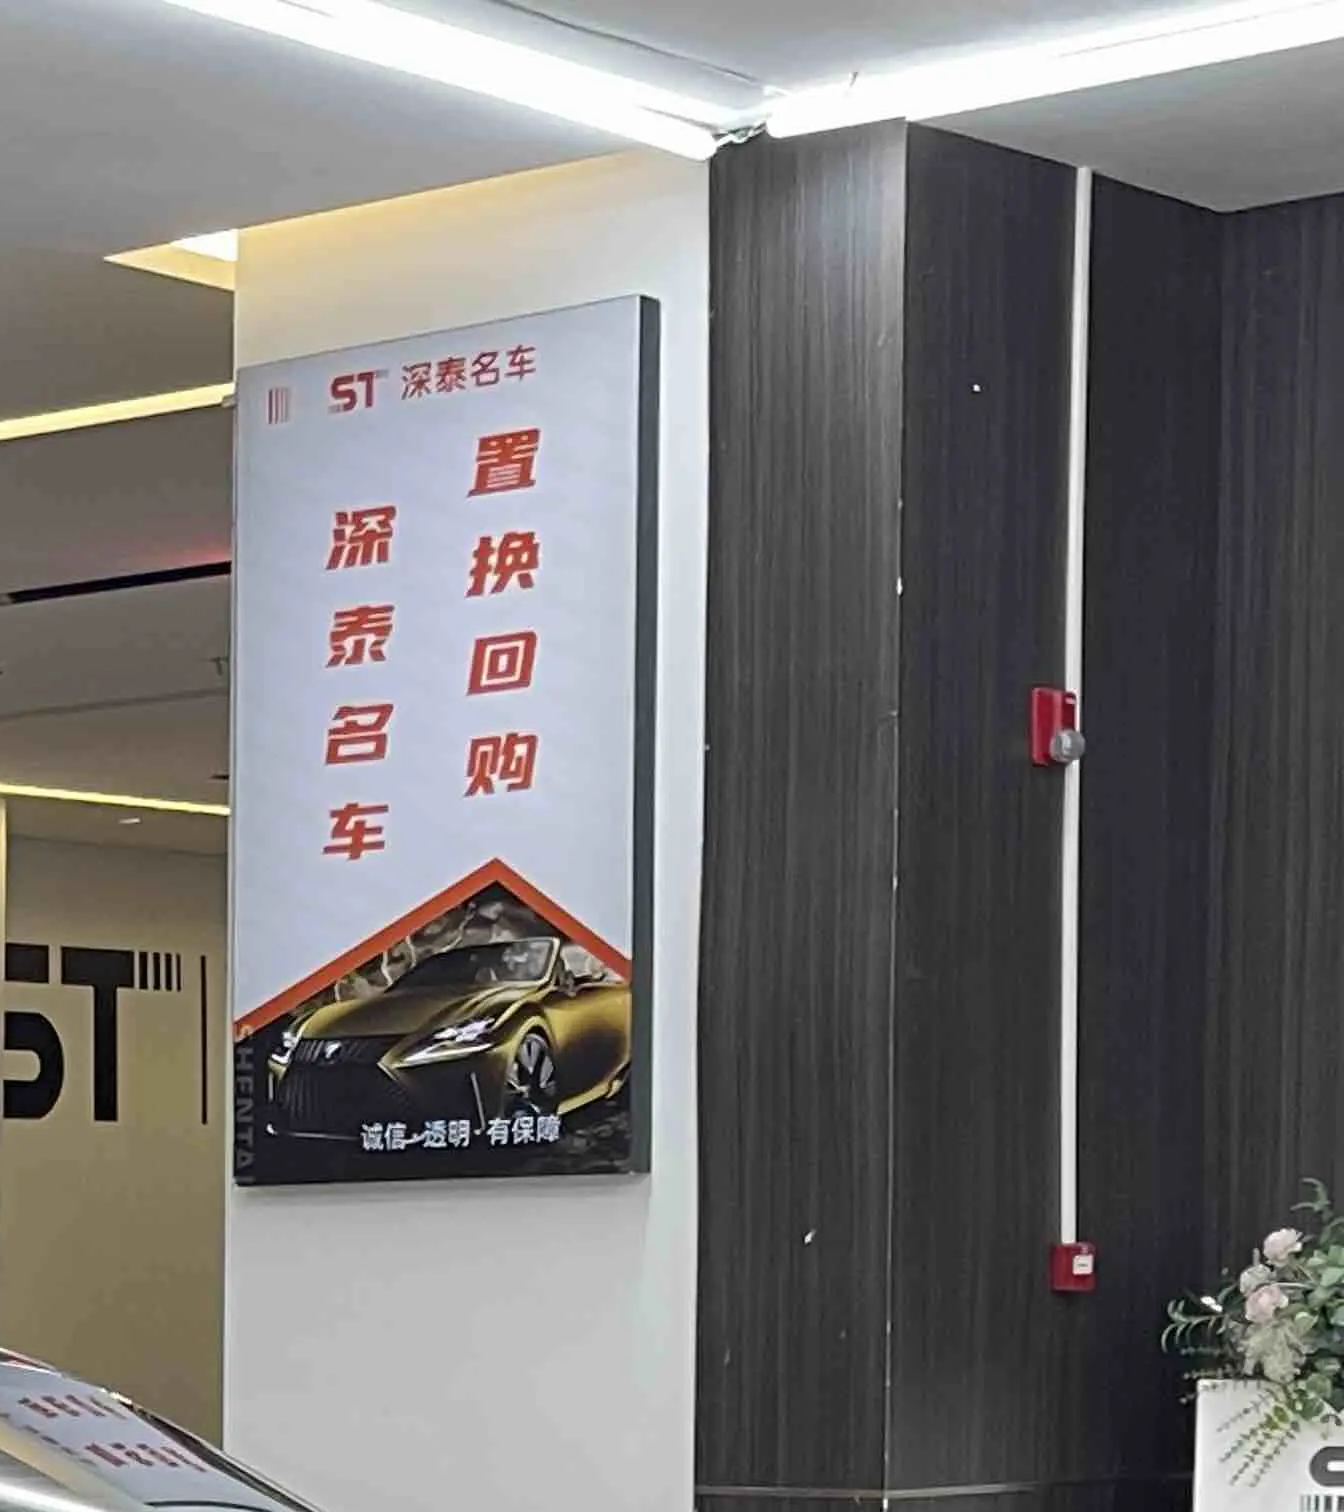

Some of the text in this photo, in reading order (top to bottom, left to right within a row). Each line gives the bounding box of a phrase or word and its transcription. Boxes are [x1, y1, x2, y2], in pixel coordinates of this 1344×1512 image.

[330, 344, 537, 411] ST 深泰名车
[322, 505, 397, 861] 深泰名车
[463, 427, 541, 798] 置换回购
